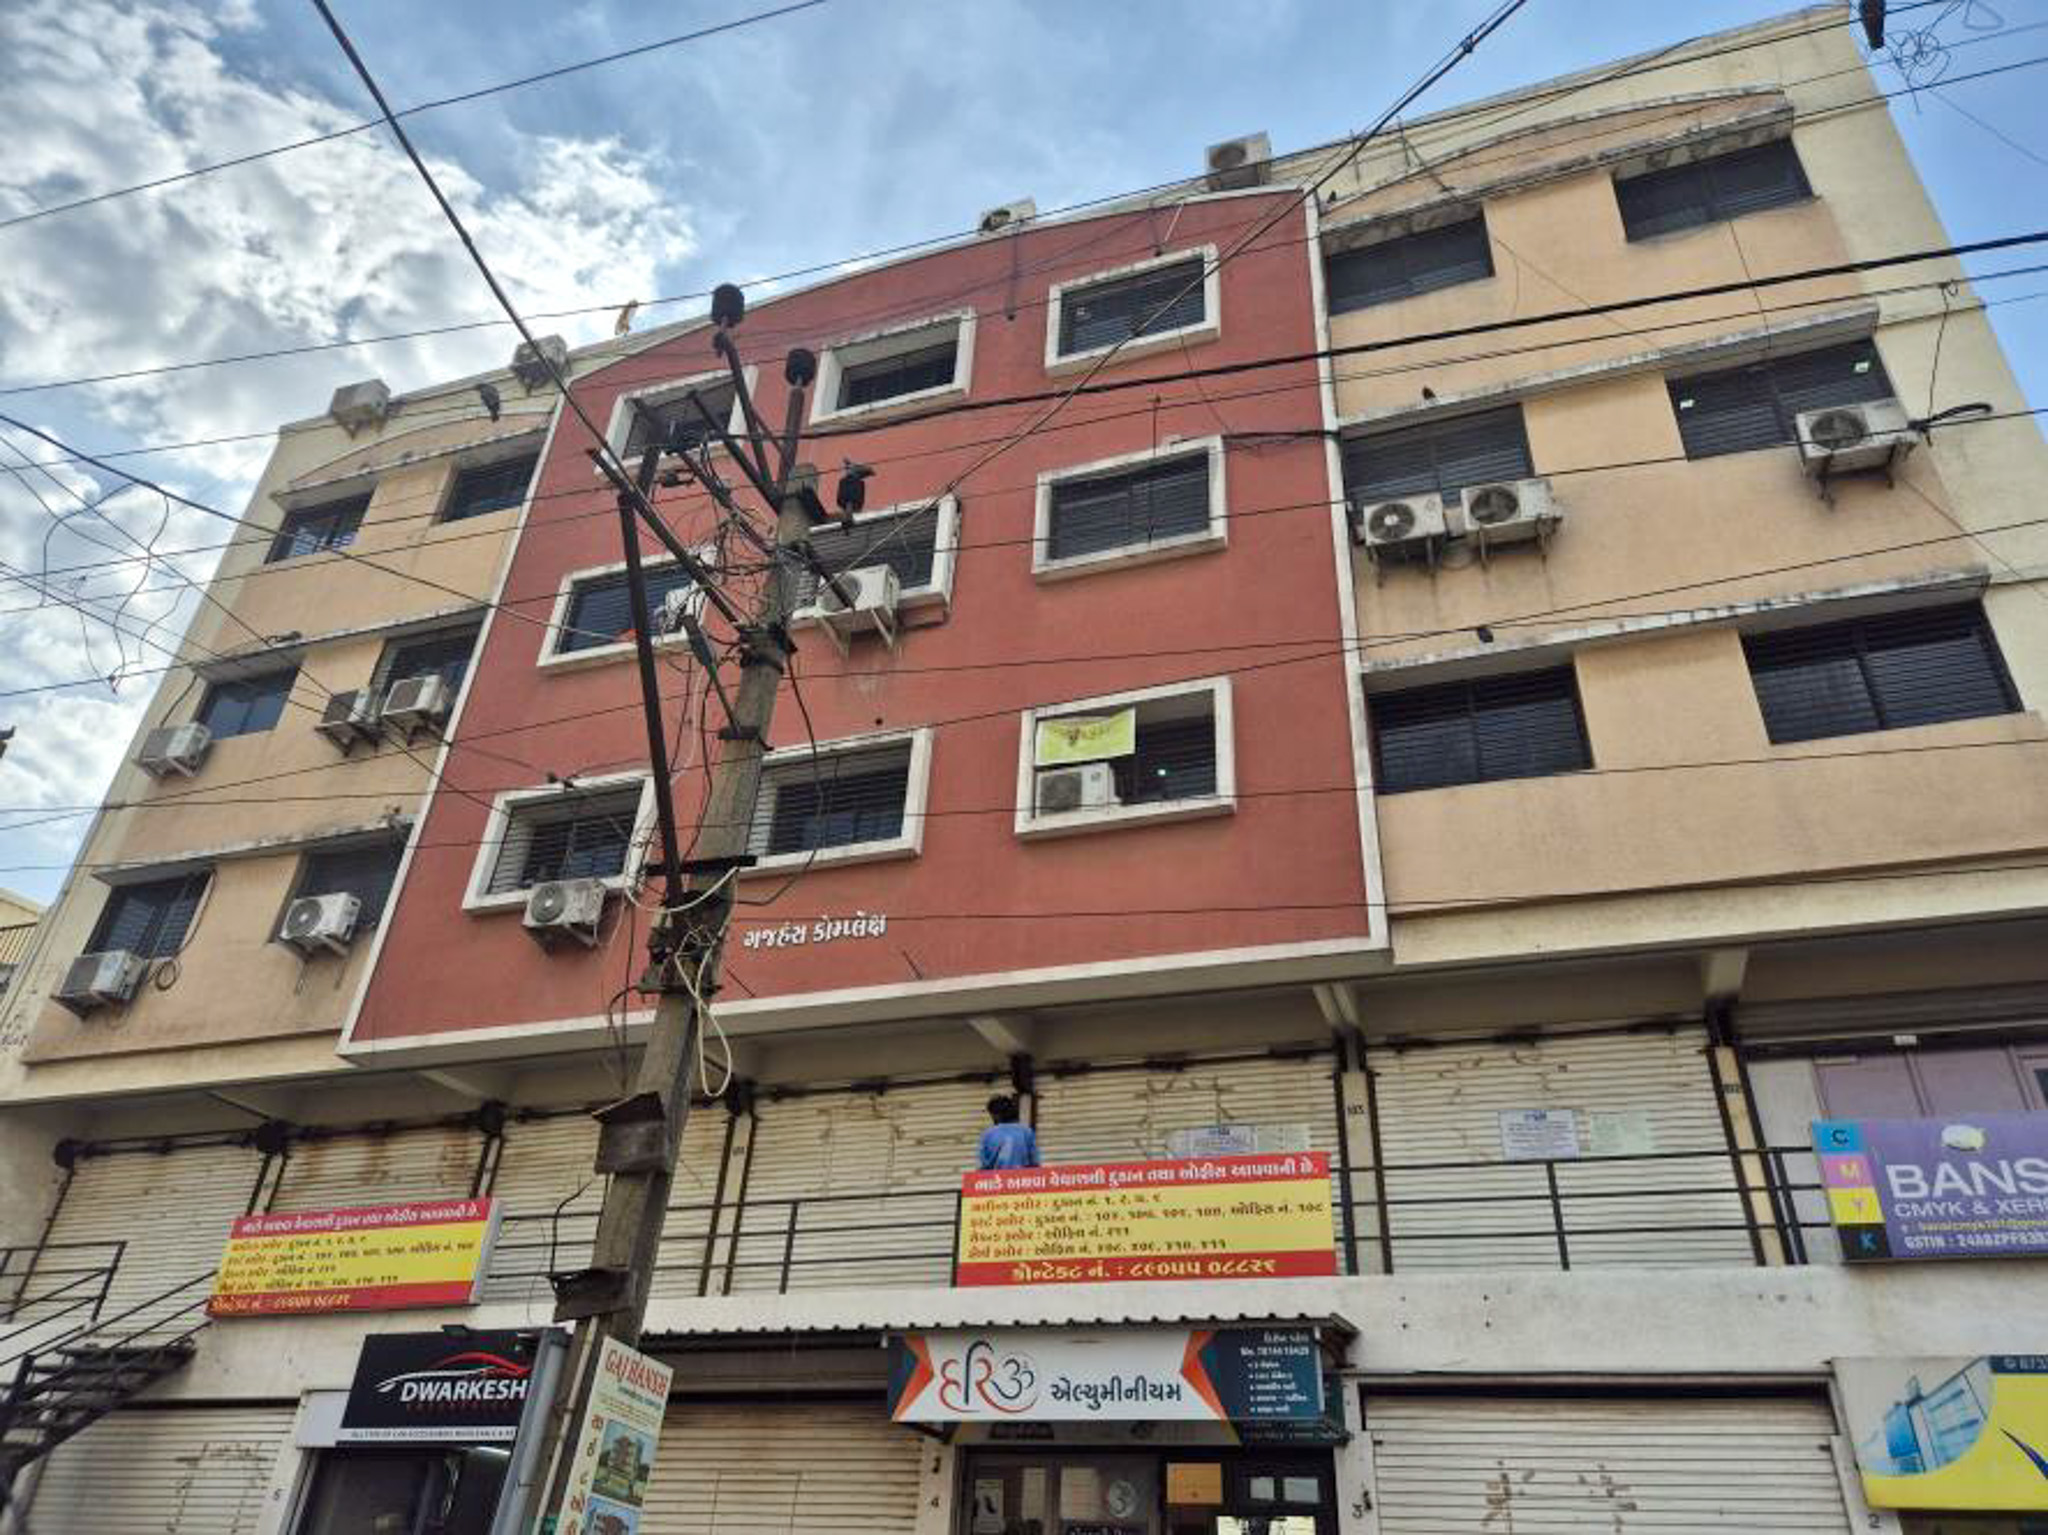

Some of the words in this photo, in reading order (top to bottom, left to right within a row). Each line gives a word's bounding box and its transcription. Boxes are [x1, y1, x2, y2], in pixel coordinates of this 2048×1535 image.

[1832, 1128, 1849, 1146] C
[1860, 1233, 1878, 1251] K
[401, 1379, 528, 1402] DWARKESH
[1050, 1375, 1182, 1410] એલ્યુમીનીયમ
